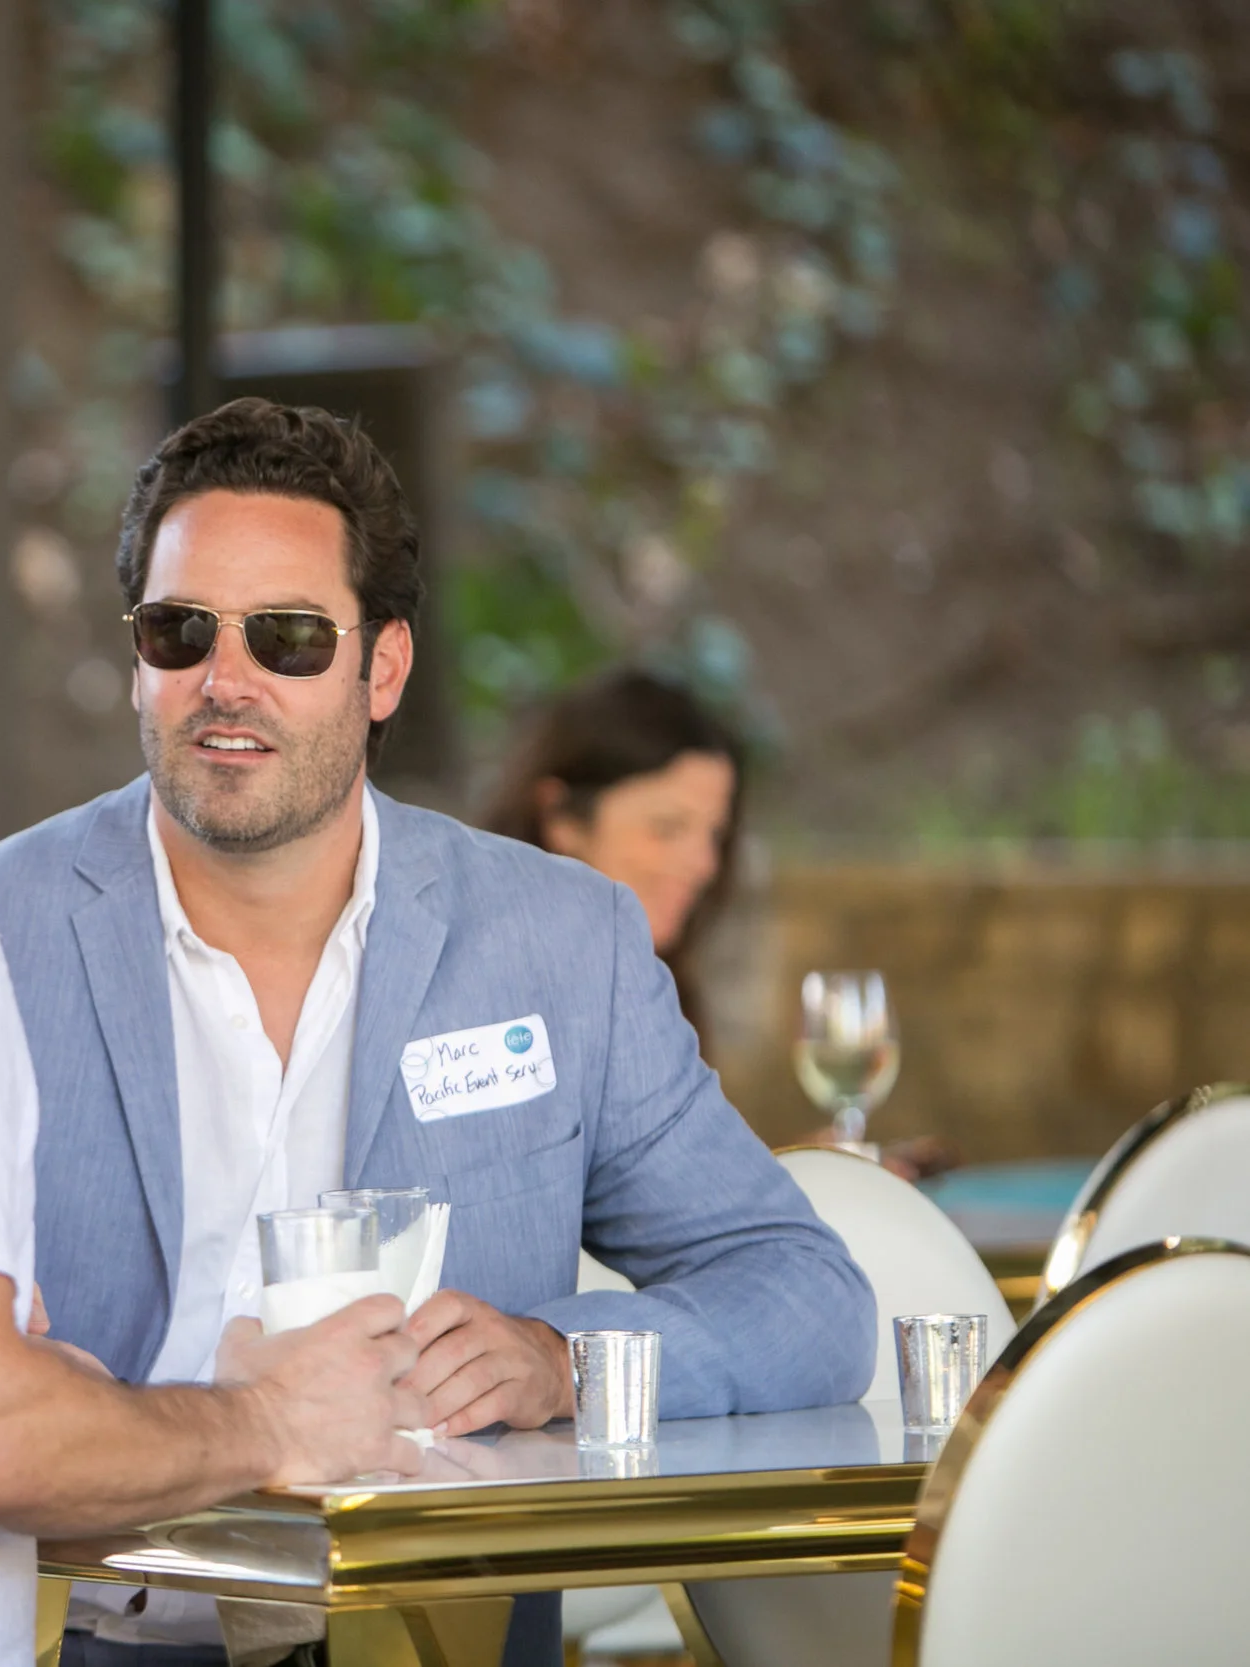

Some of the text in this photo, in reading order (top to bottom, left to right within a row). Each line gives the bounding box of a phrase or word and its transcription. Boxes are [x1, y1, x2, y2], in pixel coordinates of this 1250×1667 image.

[437, 1042, 480, 1067] Marc
[410, 1076, 463, 1105] Pacific
[465, 1067, 499, 1094] Event
